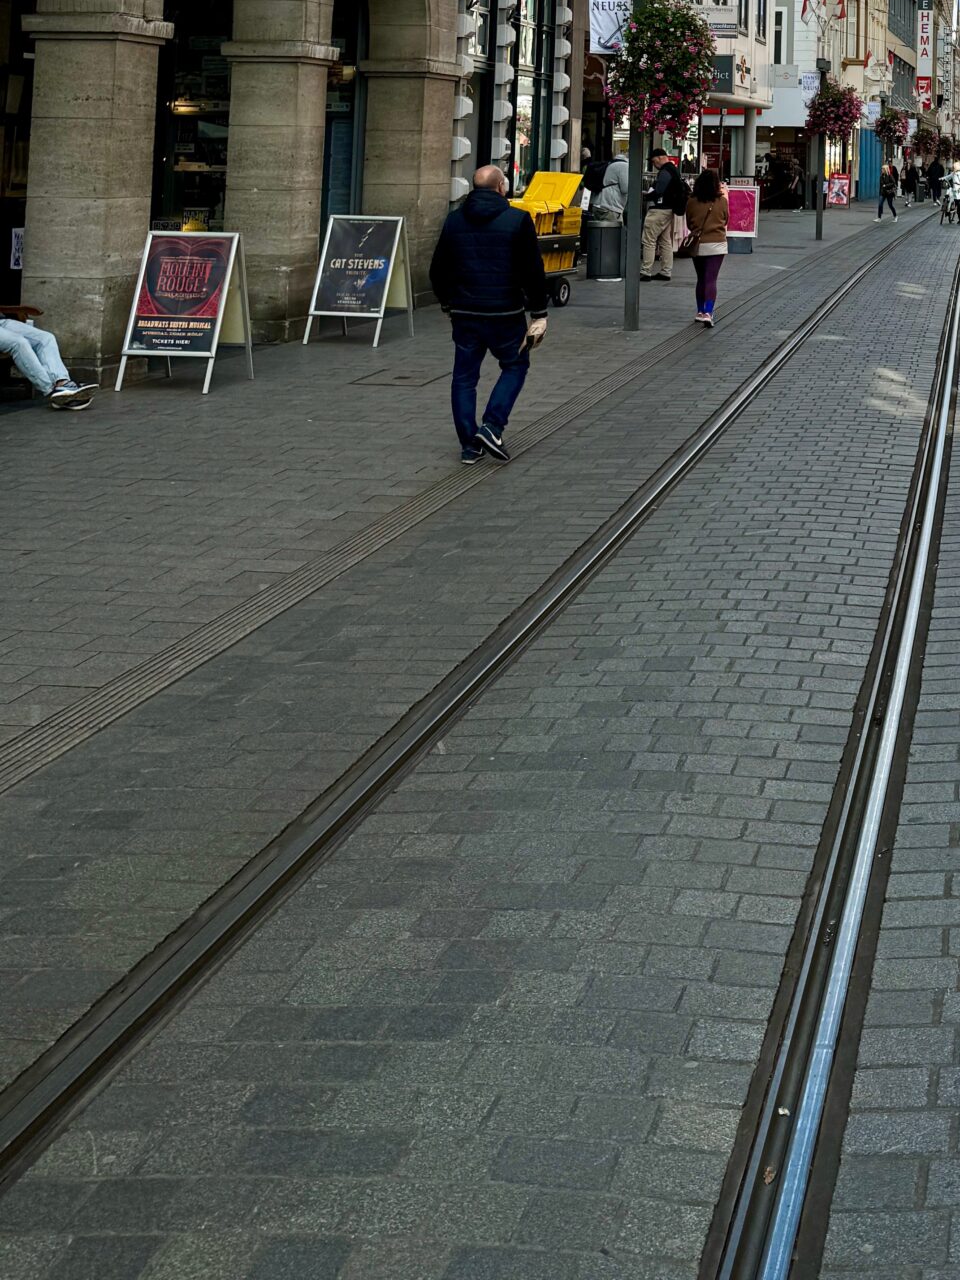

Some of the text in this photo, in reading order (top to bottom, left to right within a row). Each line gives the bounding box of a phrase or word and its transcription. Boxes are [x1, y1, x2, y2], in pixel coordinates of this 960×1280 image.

[592, 1, 630, 12] NEUSS
[920, 11, 930, 58] HEMA
[159, 261, 206, 277] MOULIN
[330, 258, 386, 270] CAT STEVENS
[137, 319, 169, 329] BROADWAYS
[188, 321, 212, 329] MUSICAL
